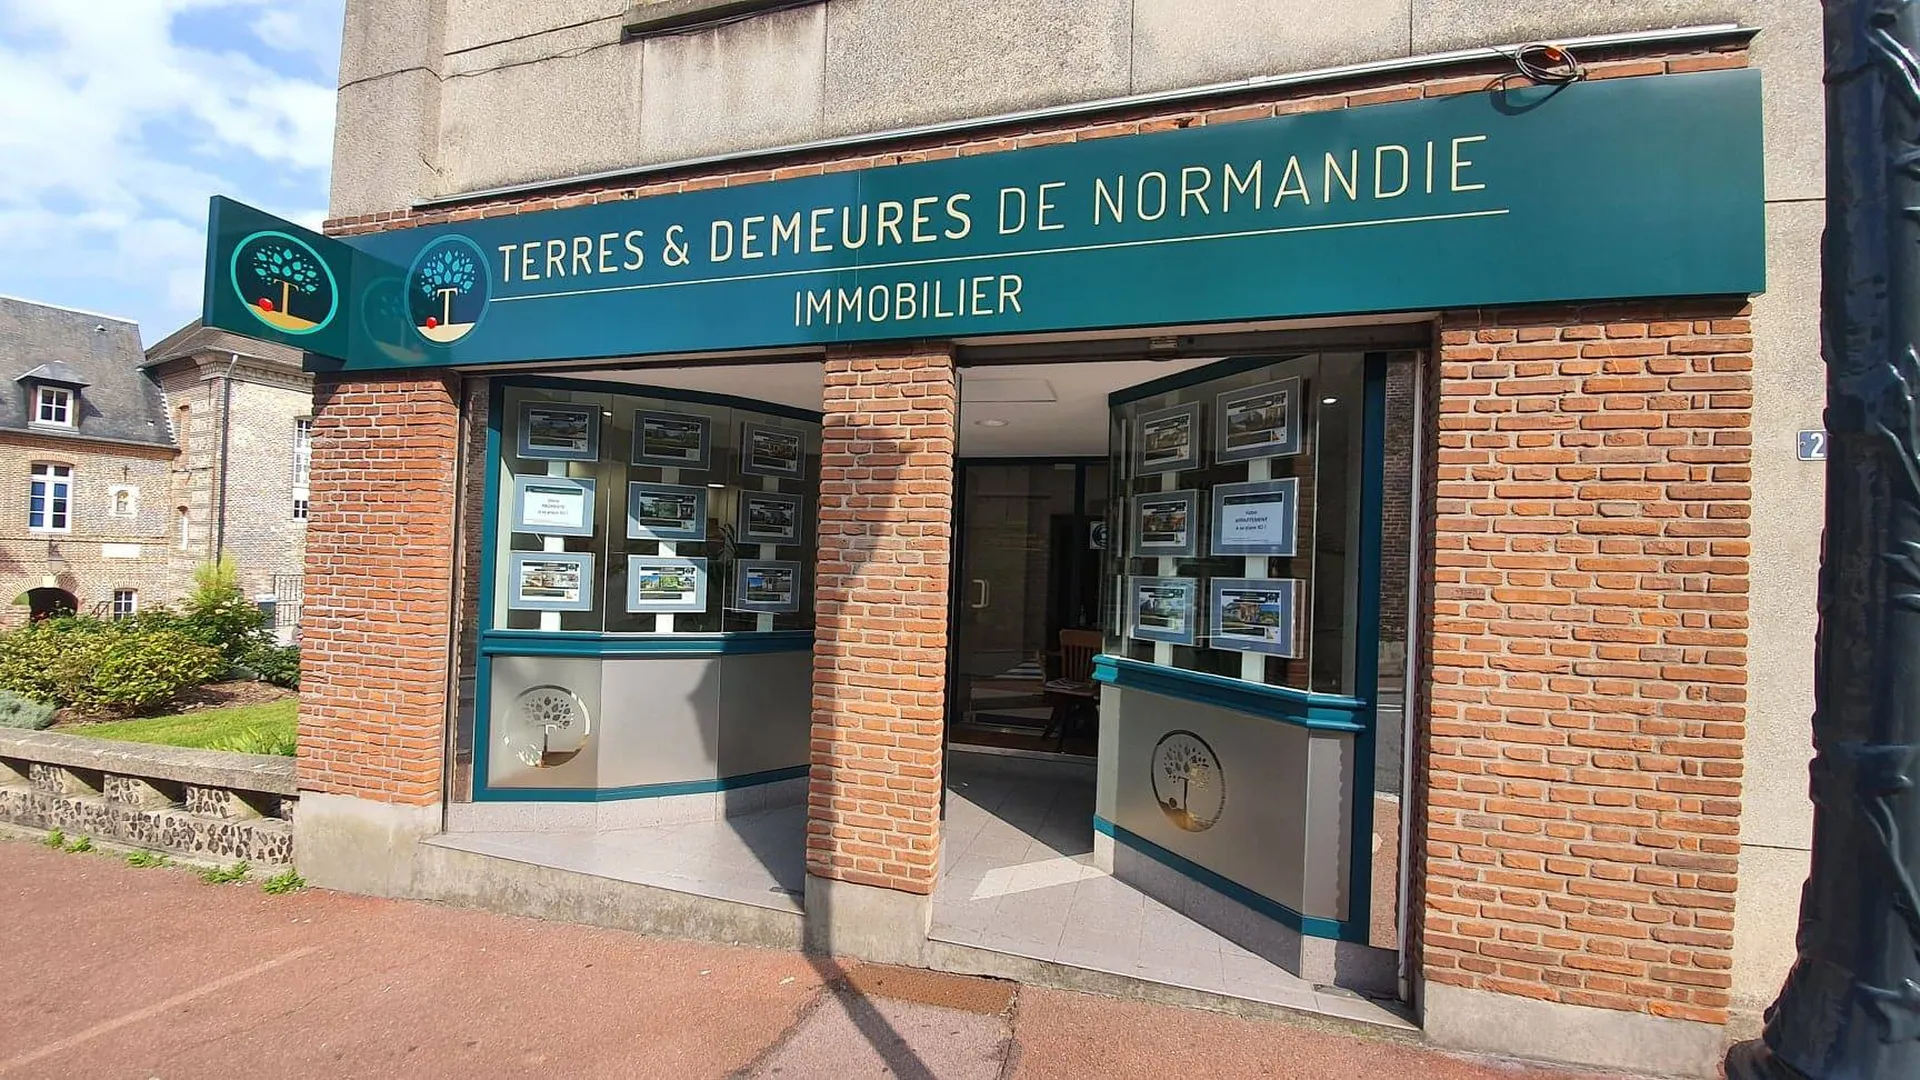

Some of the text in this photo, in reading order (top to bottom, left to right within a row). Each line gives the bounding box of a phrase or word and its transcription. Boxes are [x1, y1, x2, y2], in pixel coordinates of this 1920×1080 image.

[498, 135, 1487, 283] TERRES & DEMEURES DE NORMANDIE
[795, 274, 1023, 327] IMMOBILIER
[1810, 432, 1825, 458] 2
